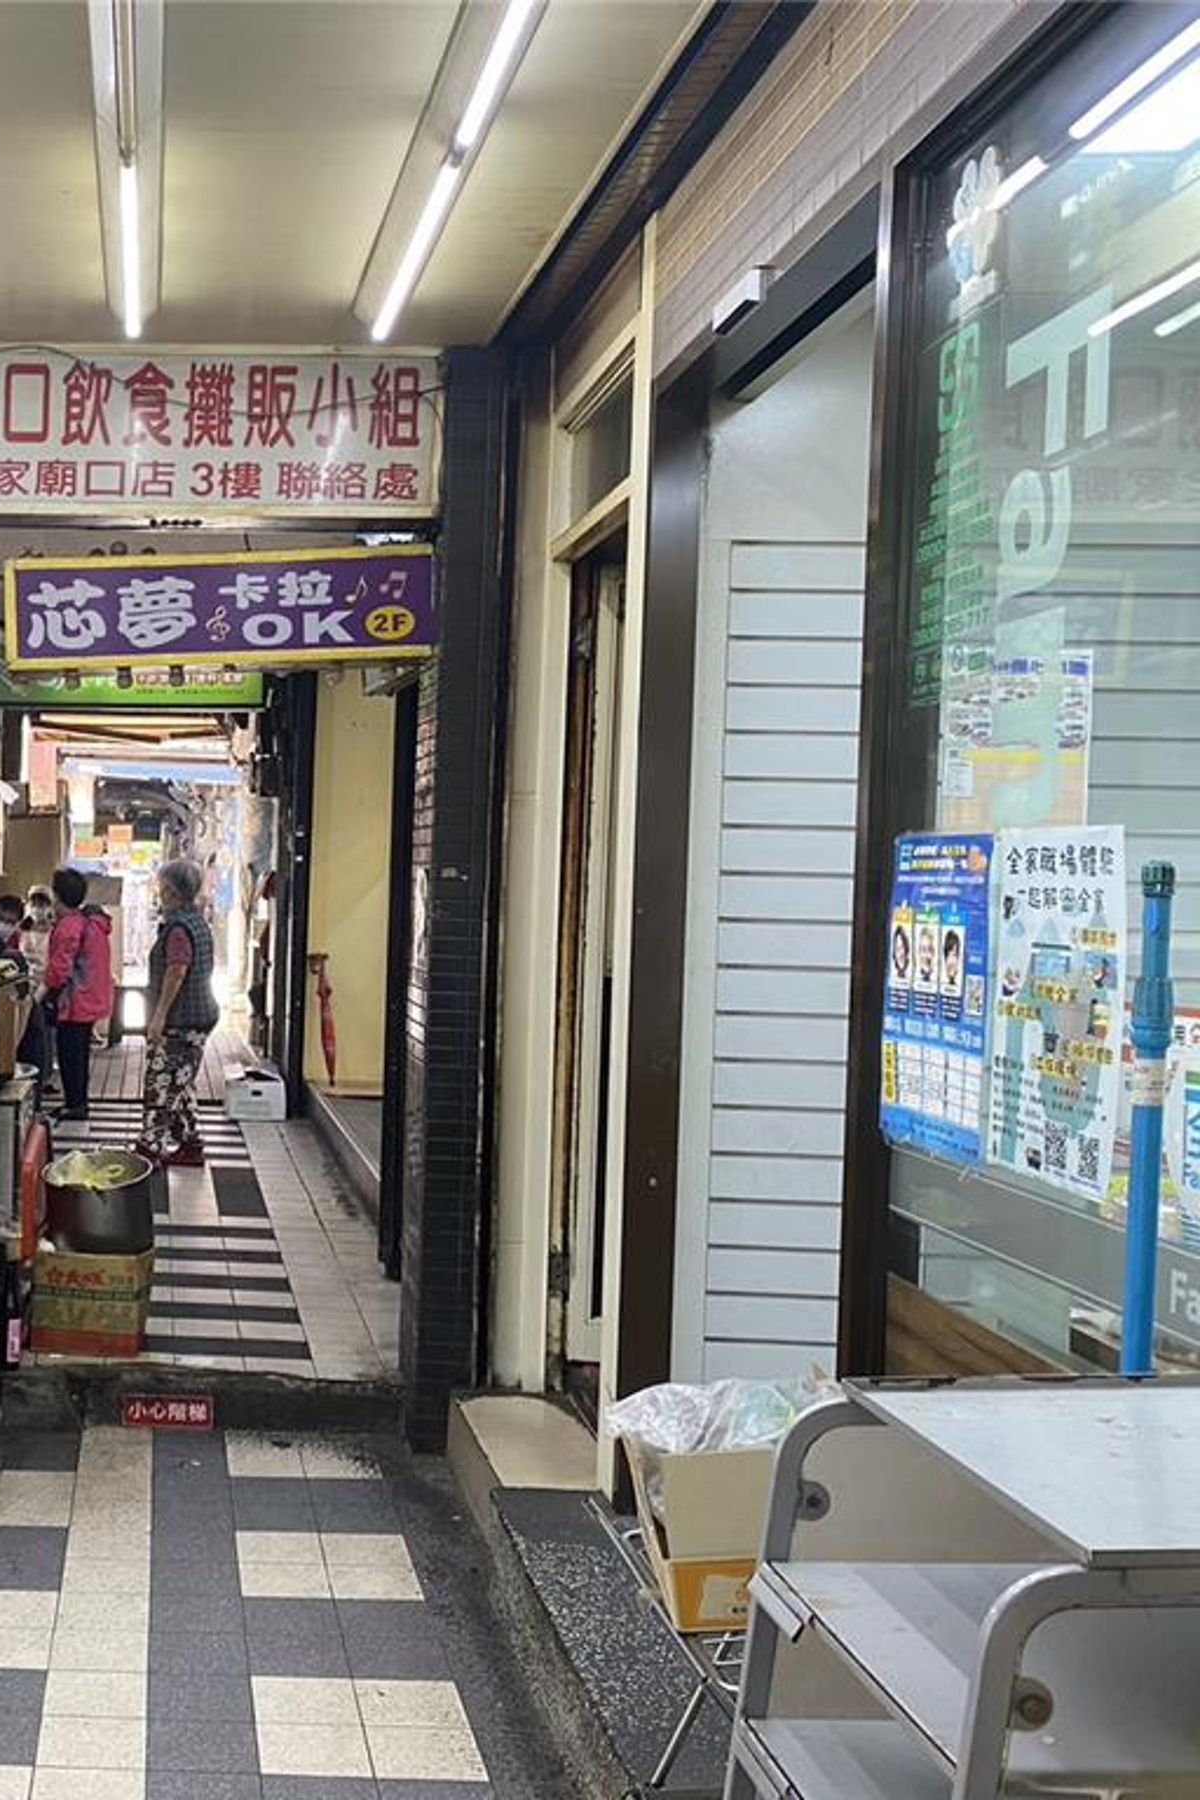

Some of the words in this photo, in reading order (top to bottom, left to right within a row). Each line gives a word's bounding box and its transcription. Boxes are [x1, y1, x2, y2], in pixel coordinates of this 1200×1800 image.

[190, 462, 262, 499] 3樓
[277, 462, 418, 500] 聯絡處
[218, 570, 334, 610] 卡拉
[27, 575, 197, 650] 芯夢
[242, 609, 355, 647] OK
[374, 612, 407, 634] 2F
